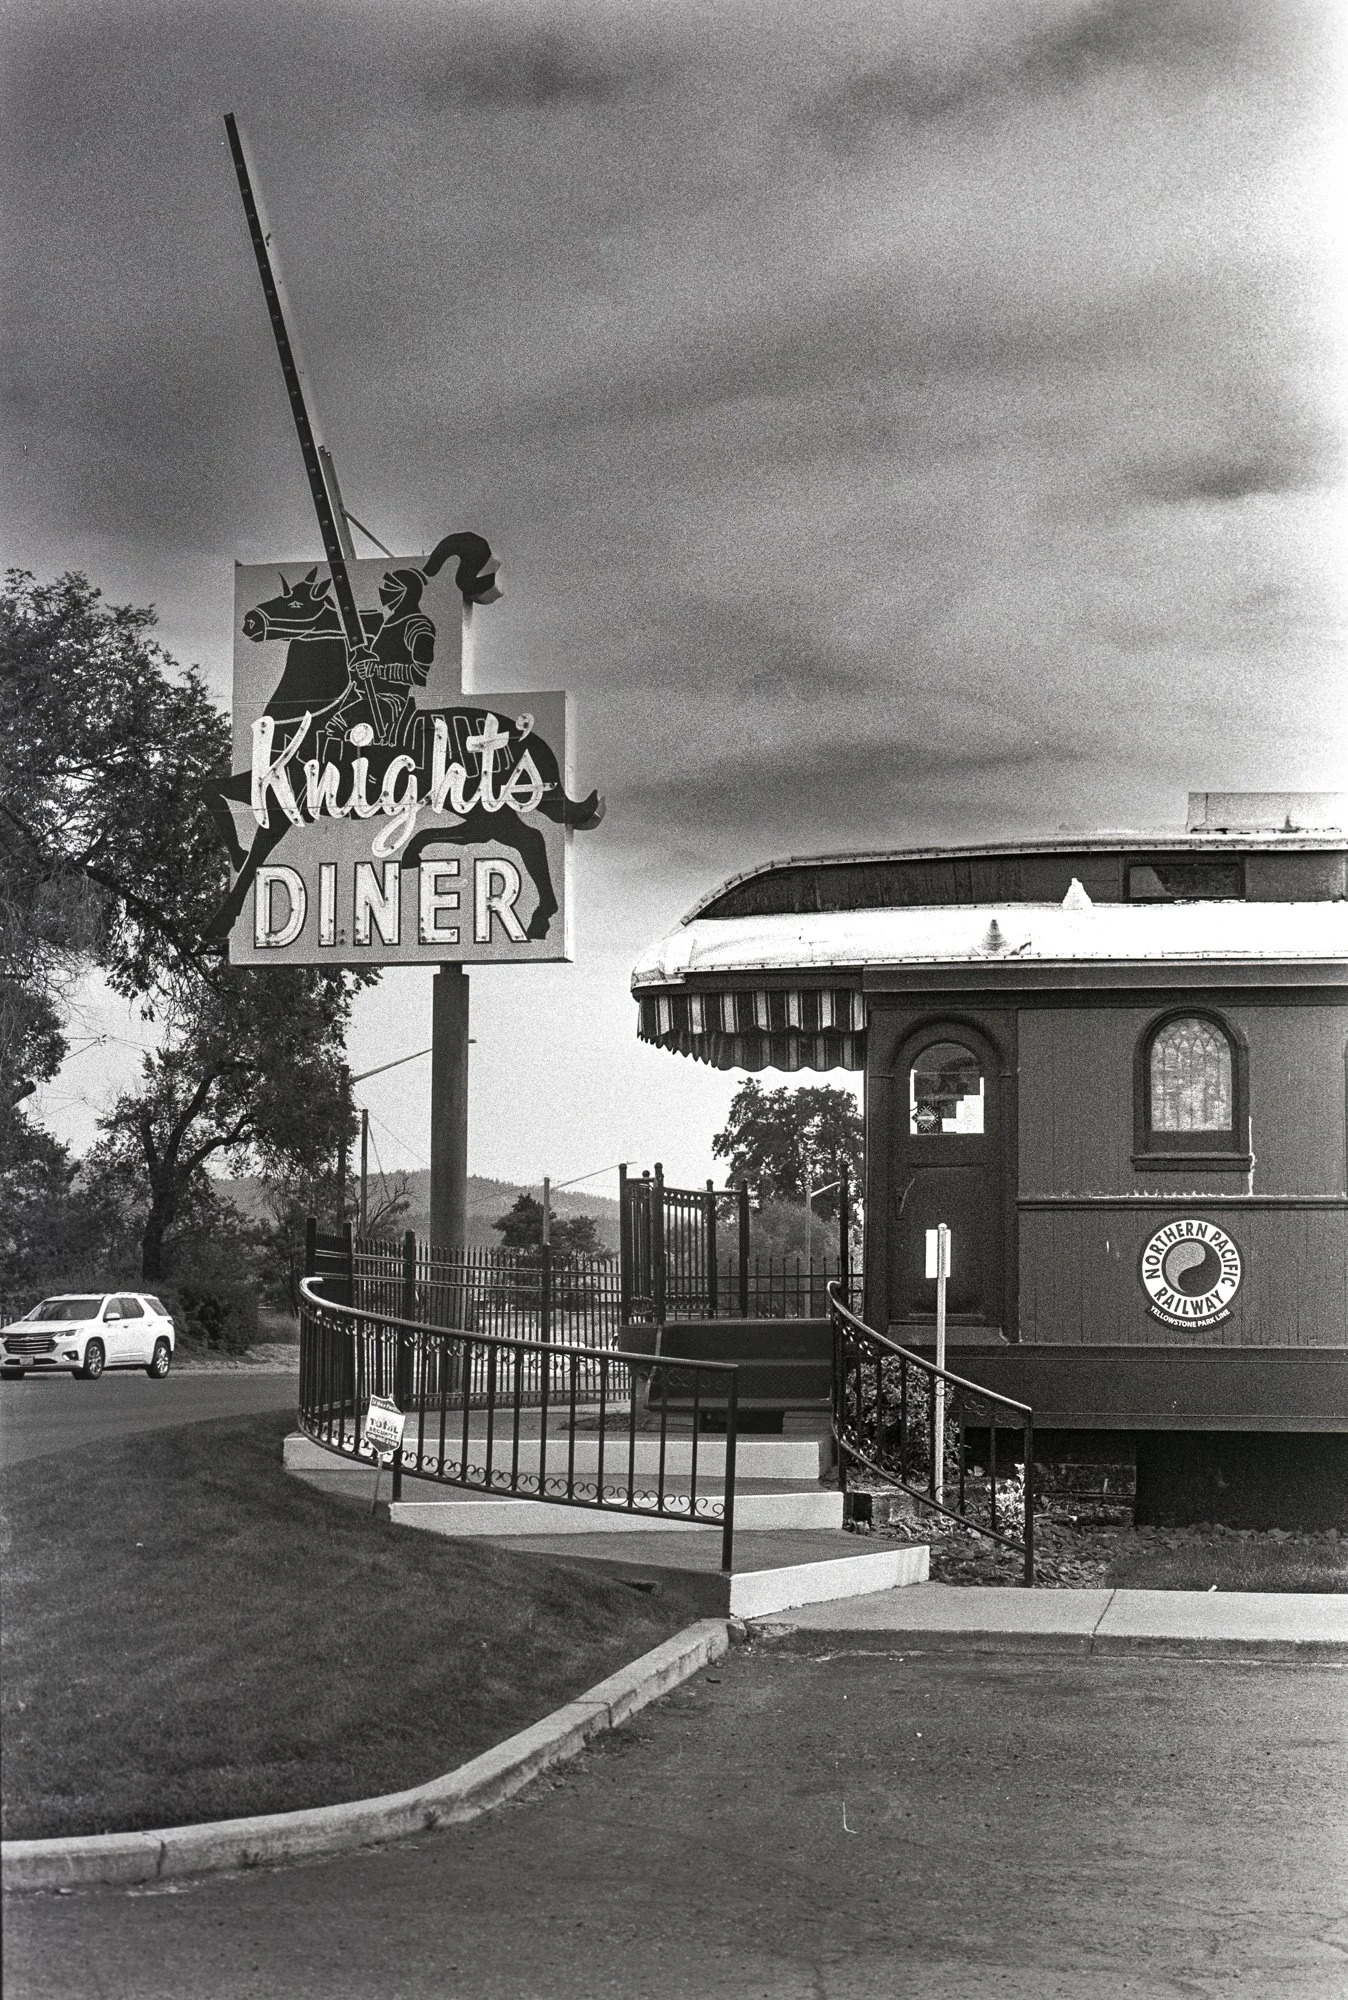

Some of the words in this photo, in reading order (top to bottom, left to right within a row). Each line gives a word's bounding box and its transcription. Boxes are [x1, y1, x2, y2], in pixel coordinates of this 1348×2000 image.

[250, 710, 558, 857] Knight's
[253, 858, 531, 948] DINER
[1145, 1222, 1208, 1280] NORTHERN
[1209, 1230, 1238, 1287] PACIFIC
[1150, 1305, 1197, 1328] YELLOWSTONE
[1197, 1317, 1215, 1327] PARK
[1215, 1308, 1231, 1320] LINE
[1153, 1286, 1224, 1315] RAILWAY
[369, 1426, 398, 1440] SECURITY
